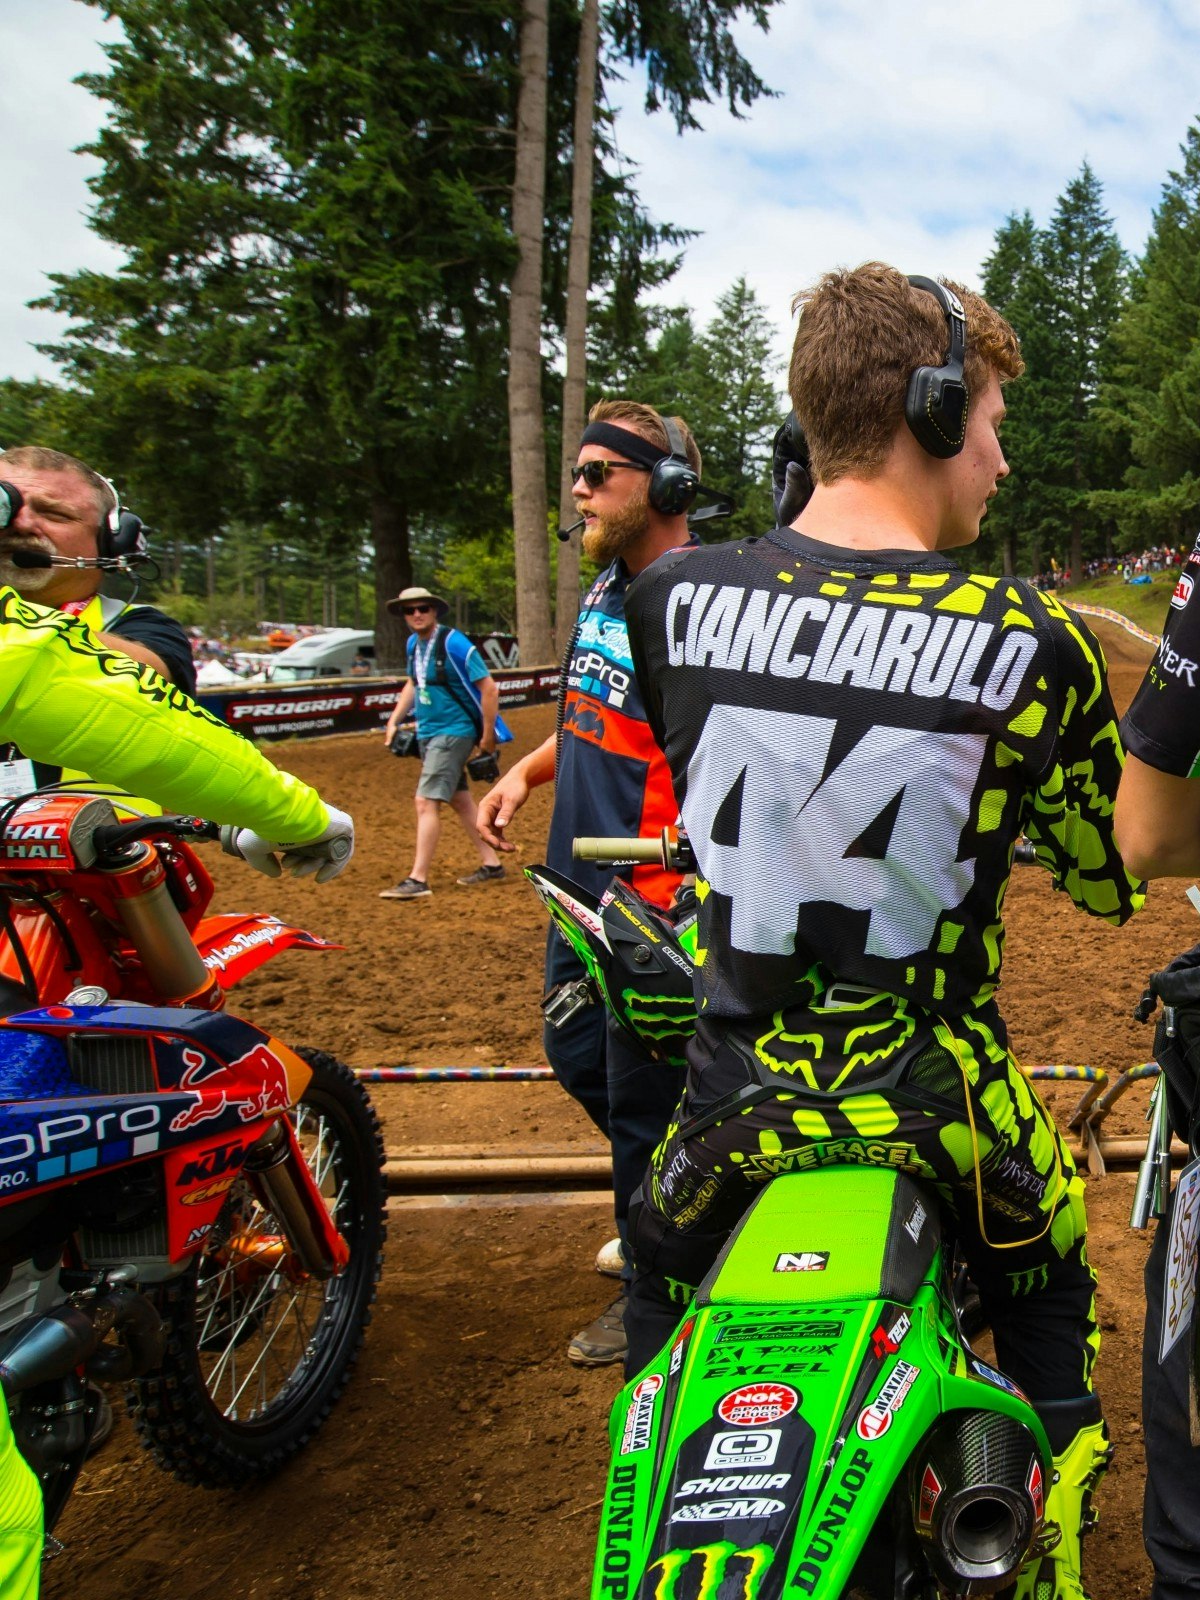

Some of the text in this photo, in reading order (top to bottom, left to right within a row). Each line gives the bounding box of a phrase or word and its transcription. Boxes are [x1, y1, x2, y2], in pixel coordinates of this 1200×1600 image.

[665, 581, 1039, 711] CIANCIARULO
[569, 652, 631, 692] oPro
[232, 697, 353, 718] PROGRIP
[3, 824, 62, 840] HAL
[680, 703, 989, 958] 44
[6, 844, 67, 858] HAL
[0, 1104, 161, 1164] oPro
[760, 1149, 818, 1173] WE
[826, 1142, 909, 1165] RACE
[721, 1335, 759, 1343] WORKS
[724, 1323, 840, 1337] WRP
[701, 1362, 831, 1380] EXCEL
[733, 1391, 785, 1405] NGK
[875, 1360, 912, 1416] MAXIMA
[730, 1410, 780, 1420] PLUGS
[733, 1405, 780, 1413] SPARK
[632, 1393, 653, 1451] MAXIMA
[713, 1454, 767, 1465] OGIO
[674, 1472, 792, 1499] SHOWA
[601, 1462, 638, 1600] DUNLOP
[790, 1447, 874, 1597] DUNLOP
